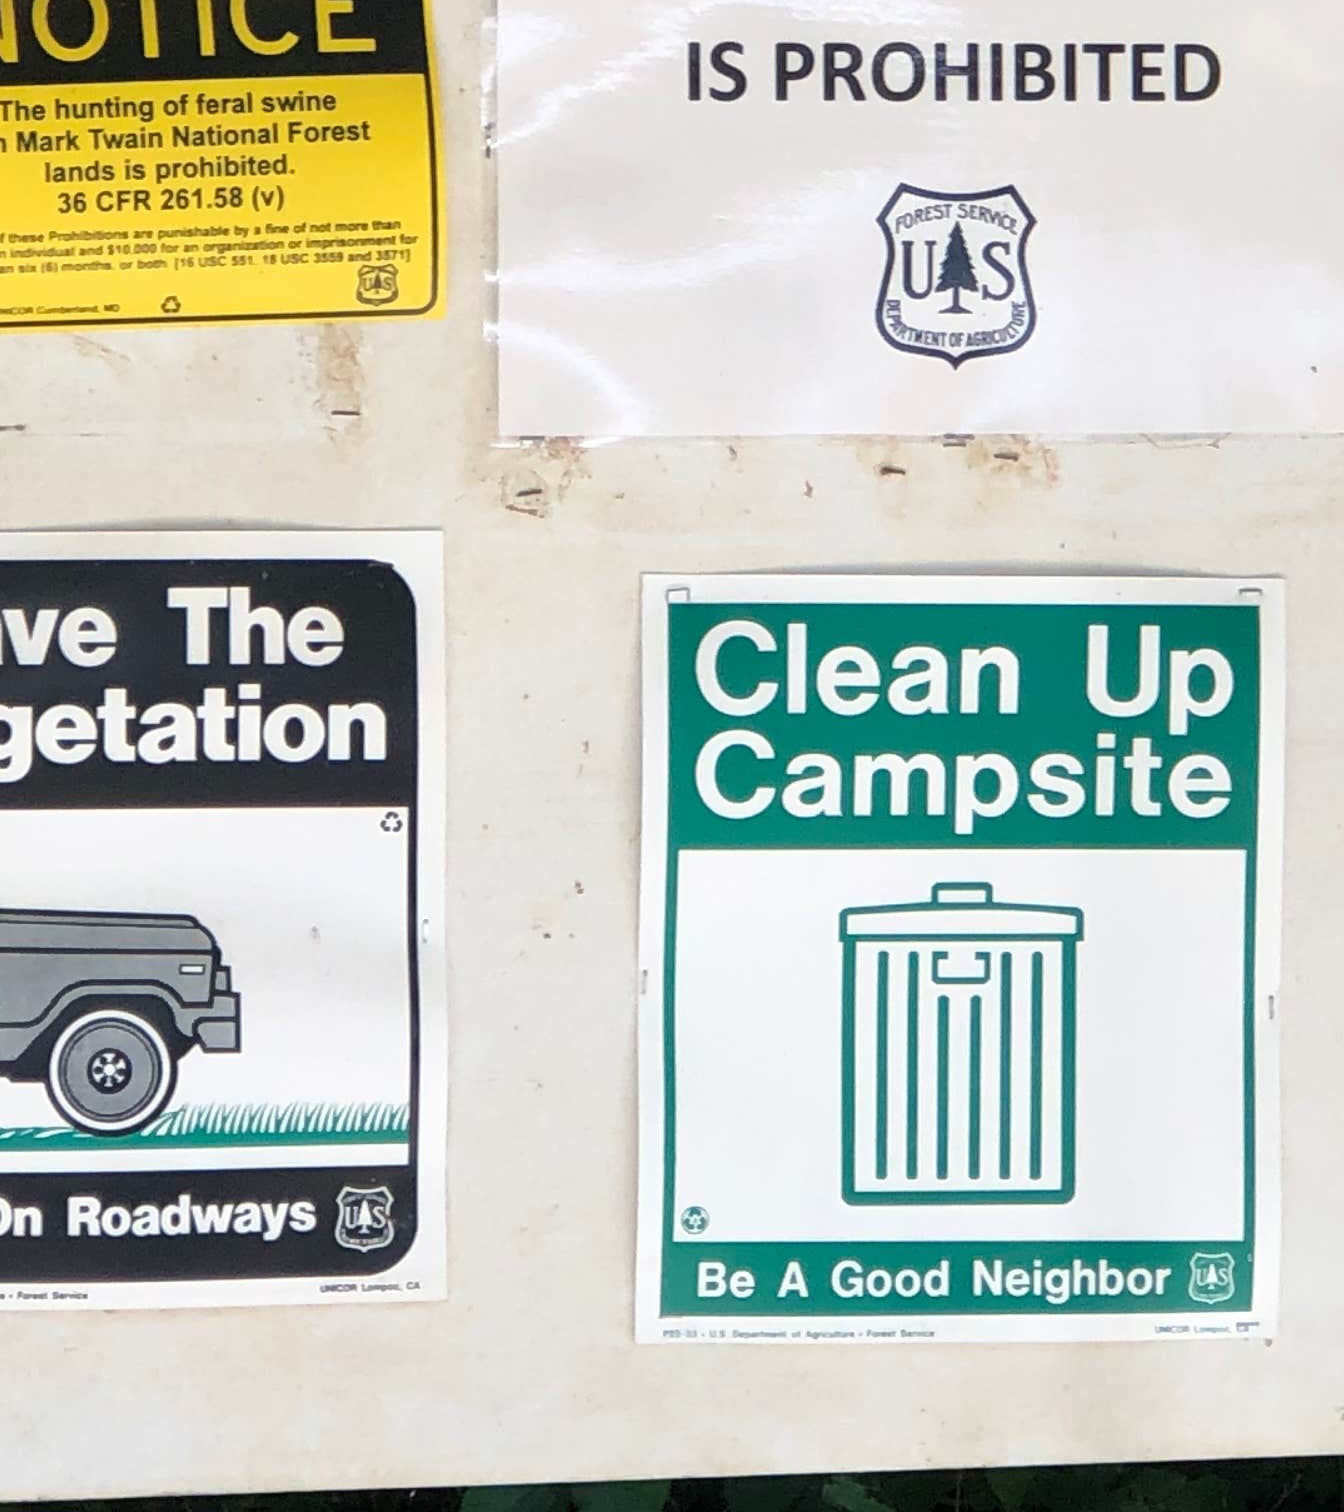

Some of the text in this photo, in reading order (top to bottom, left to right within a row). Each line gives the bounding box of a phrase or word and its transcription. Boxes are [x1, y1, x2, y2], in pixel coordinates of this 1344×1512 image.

[688, 41, 1221, 102] IS PROHIBITED
[54, 95, 154, 122] hunting
[163, 94, 189, 116] of
[196, 91, 254, 115] feral
[261, 91, 337, 113] swine
[16, 129, 80, 153] Mark
[88, 126, 163, 151] Twain
[171, 123, 280, 148] National
[287, 119, 371, 144] Forest
[44, 153, 297, 185] lands is prohibited.
[56, 184, 286, 215] 36 CFR 261.58 (v)
[8, 233, 45, 244] these
[48, 230, 130, 242] Prohibitions
[133, 229, 154, 240] are
[157, 226, 230, 240] punishable
[234, 226, 250, 239] by
[265, 223, 290, 235] fine
[293, 222, 308, 234] of
[310, 221, 332, 233] not
[335, 221, 369, 232] more
[371, 219, 402, 231] than
[895, 202, 1018, 236] FOREST SERVICE
[10, 245, 75, 259] individual
[78, 244, 104, 257] and
[160, 241, 180, 253] for
[183, 242, 200, 252] an
[203, 238, 285, 254] organization
[288, 240, 303, 250] or
[306, 234, 396, 250] imprisonment
[399, 233, 419, 245] for
[17, 263, 37, 274] six
[118, 260, 134, 270] or
[197, 255, 227, 268] USC
[280, 252, 309, 265] USC
[347, 250, 373, 262] and
[886, 299, 1027, 348] DEPARTMENT OF AGRICULTURE
[167, 586, 345, 667] The
[695, 619, 1236, 735] Clean Up
[694, 729, 1234, 835] Campsite
[67, 1194, 317, 1241] Roadways
[16, 1290, 49, 1300] Forest
[52, 1290, 89, 1300] Service
[405, 1281, 421, 1290] CA
[697, 1261, 756, 1298] Be
[776, 1261, 809, 1298] A
[831, 1259, 950, 1298] Good
[973, 1259, 1172, 1305] Neighbor
